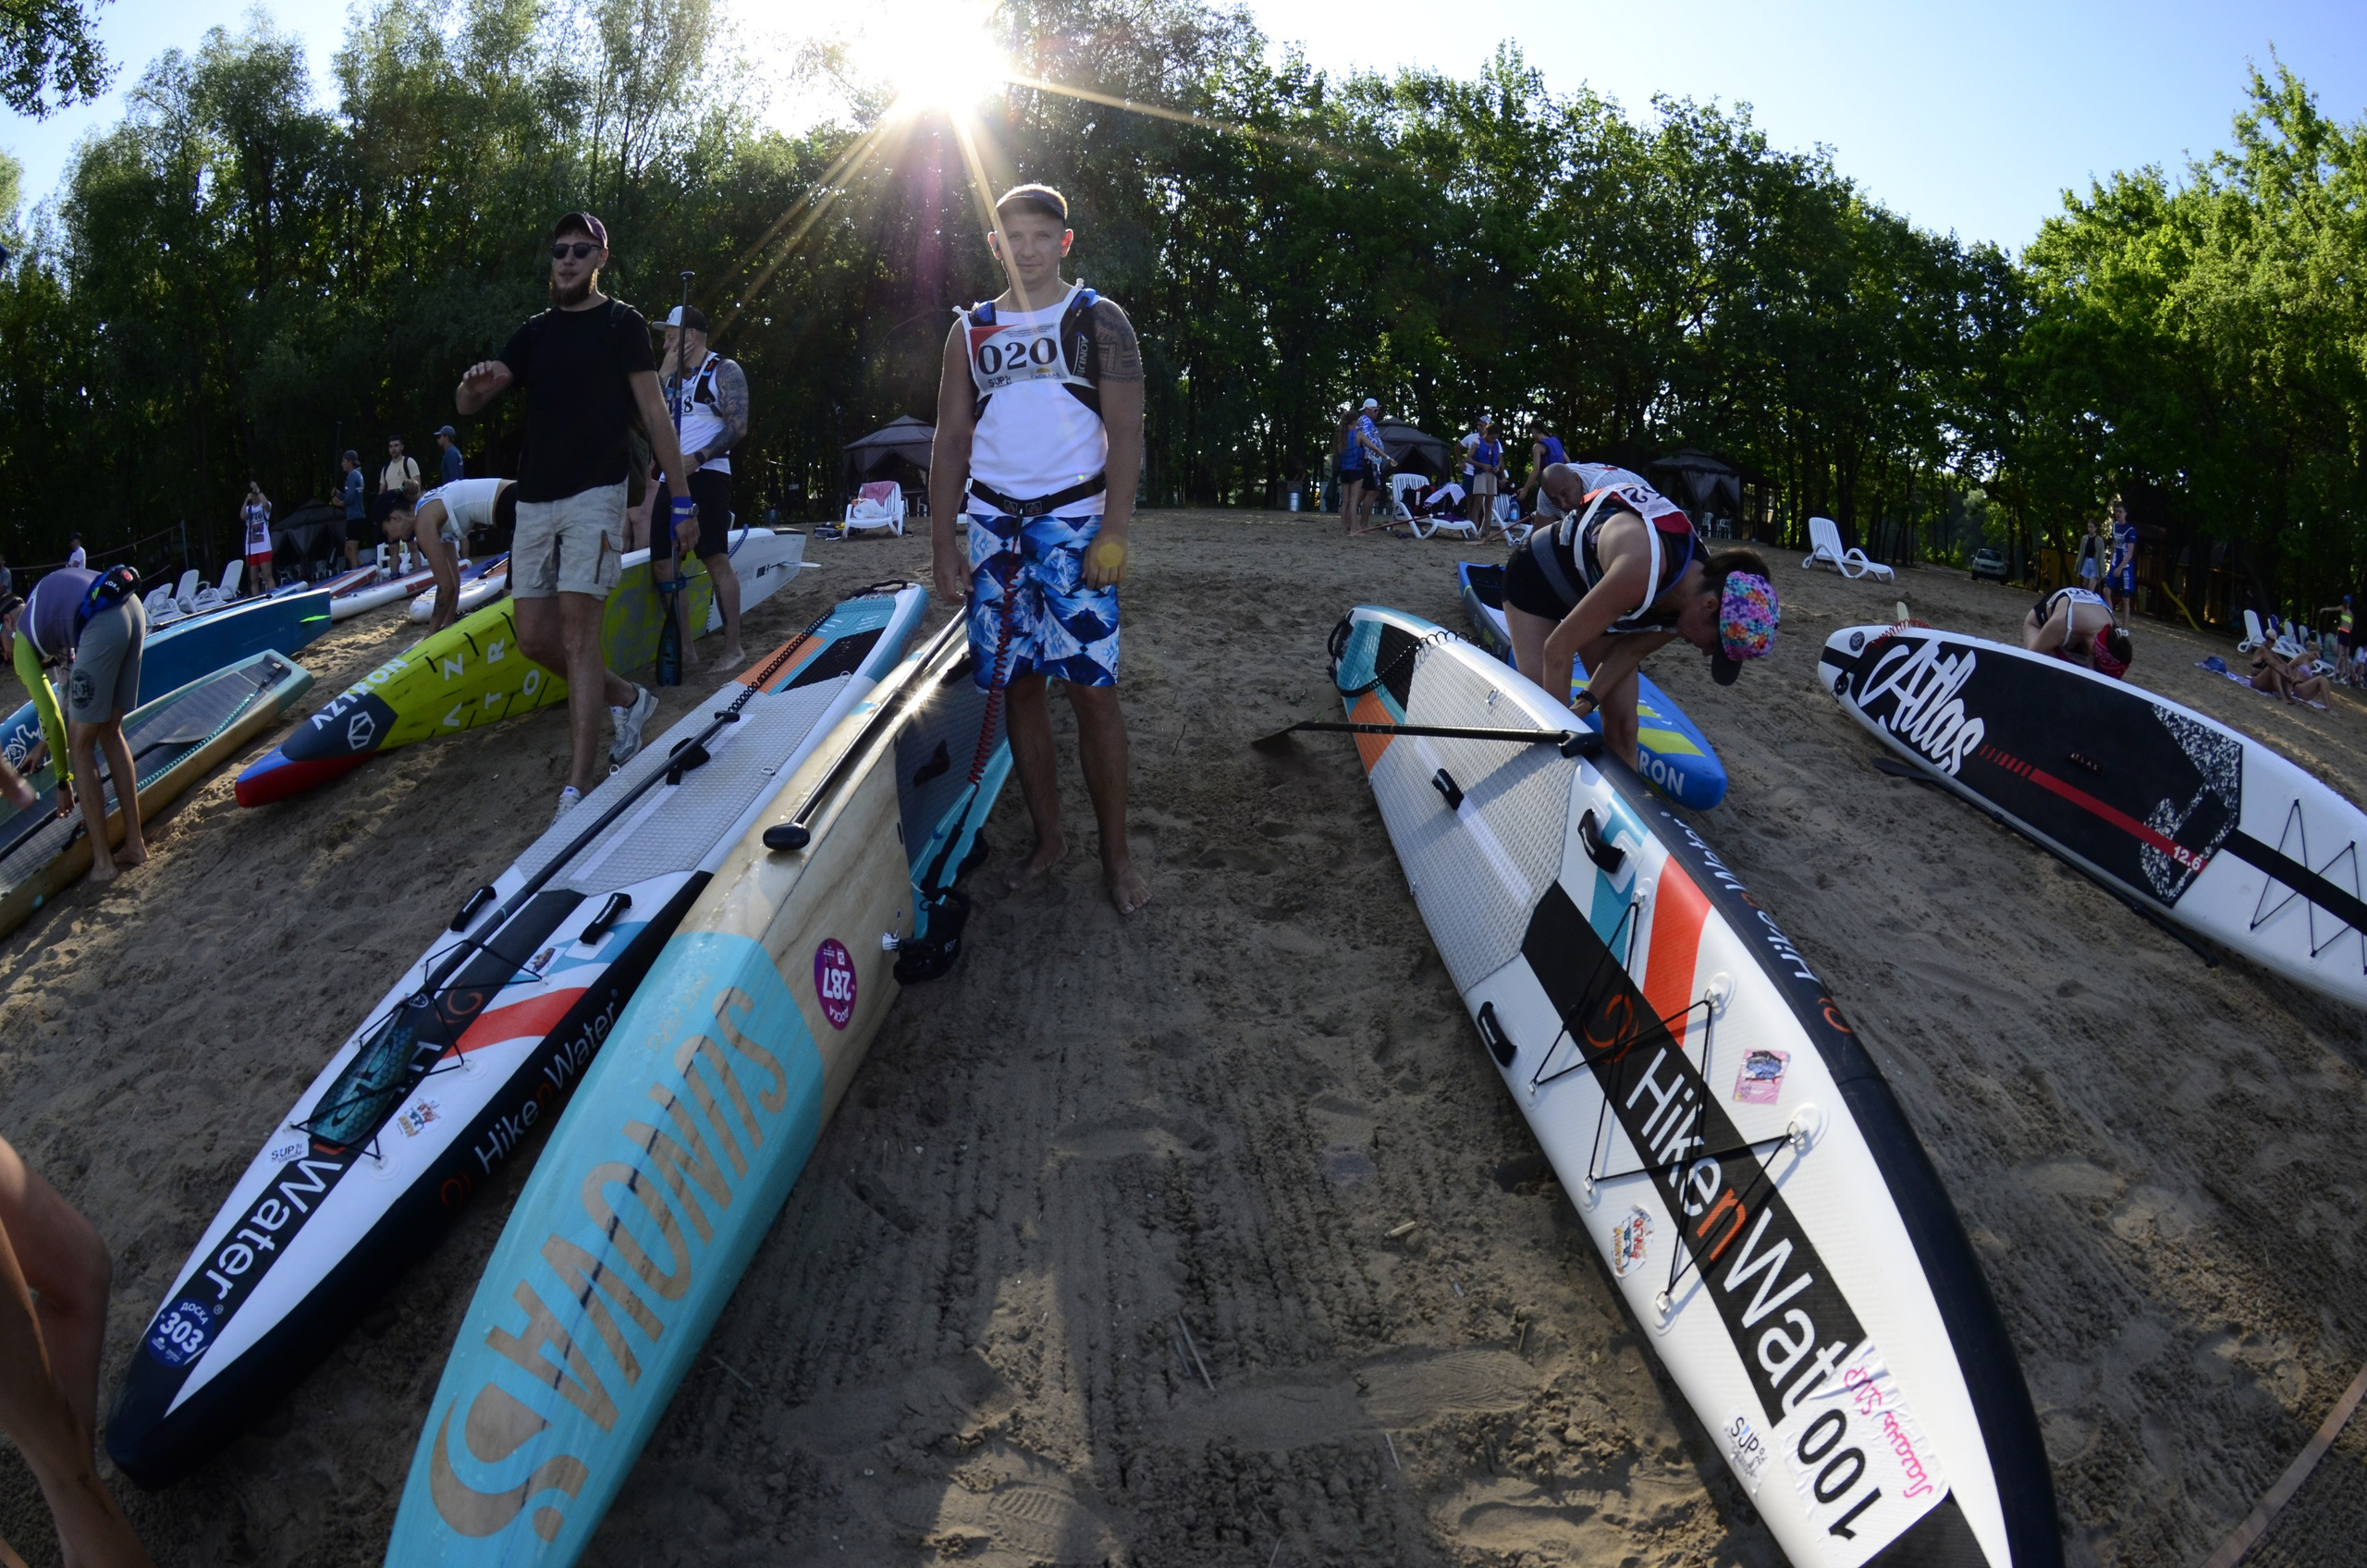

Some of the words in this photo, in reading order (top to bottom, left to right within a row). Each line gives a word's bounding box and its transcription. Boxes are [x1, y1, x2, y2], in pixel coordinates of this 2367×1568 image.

[978, 337, 1058, 374] 020
[311, 657, 409, 730] AZTRON
[1858, 639, 1984, 776] Atlas
[1637, 753, 1685, 798] RON
[2070, 752, 2100, 772] ATLAS
[2173, 845, 2201, 870] 12.6
[823, 967, 852, 1001] 287
[485, 987, 787, 1435] SUNOVA
[159, 1311, 202, 1354] 303
[180, 1302, 209, 1326] ДОСКА
[1797, 1408, 1883, 1541] 100
